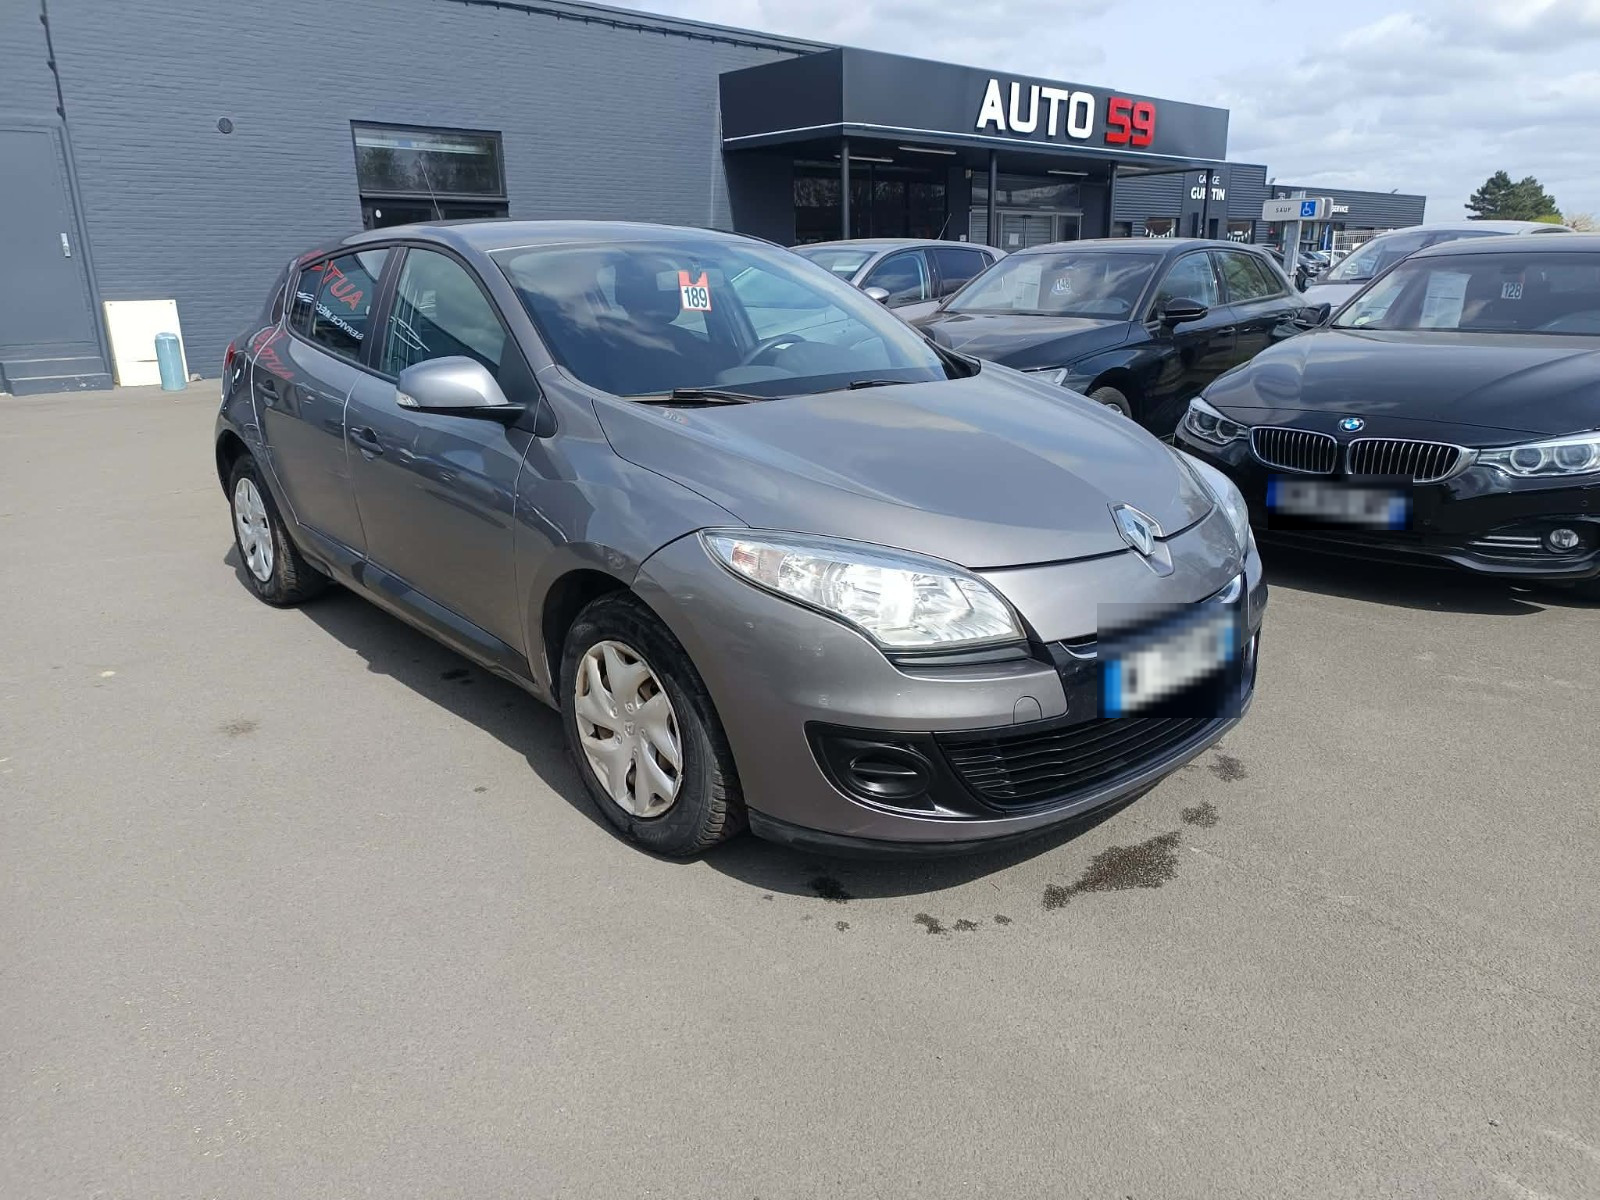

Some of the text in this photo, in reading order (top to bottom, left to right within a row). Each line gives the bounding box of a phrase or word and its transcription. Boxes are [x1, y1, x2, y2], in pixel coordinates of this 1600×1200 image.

[976, 78, 1156, 146] AUTO 59
[1198, 174, 1220, 185] GAGE
[684, 286, 708, 308] 189
[1504, 283, 1521, 298] 128
